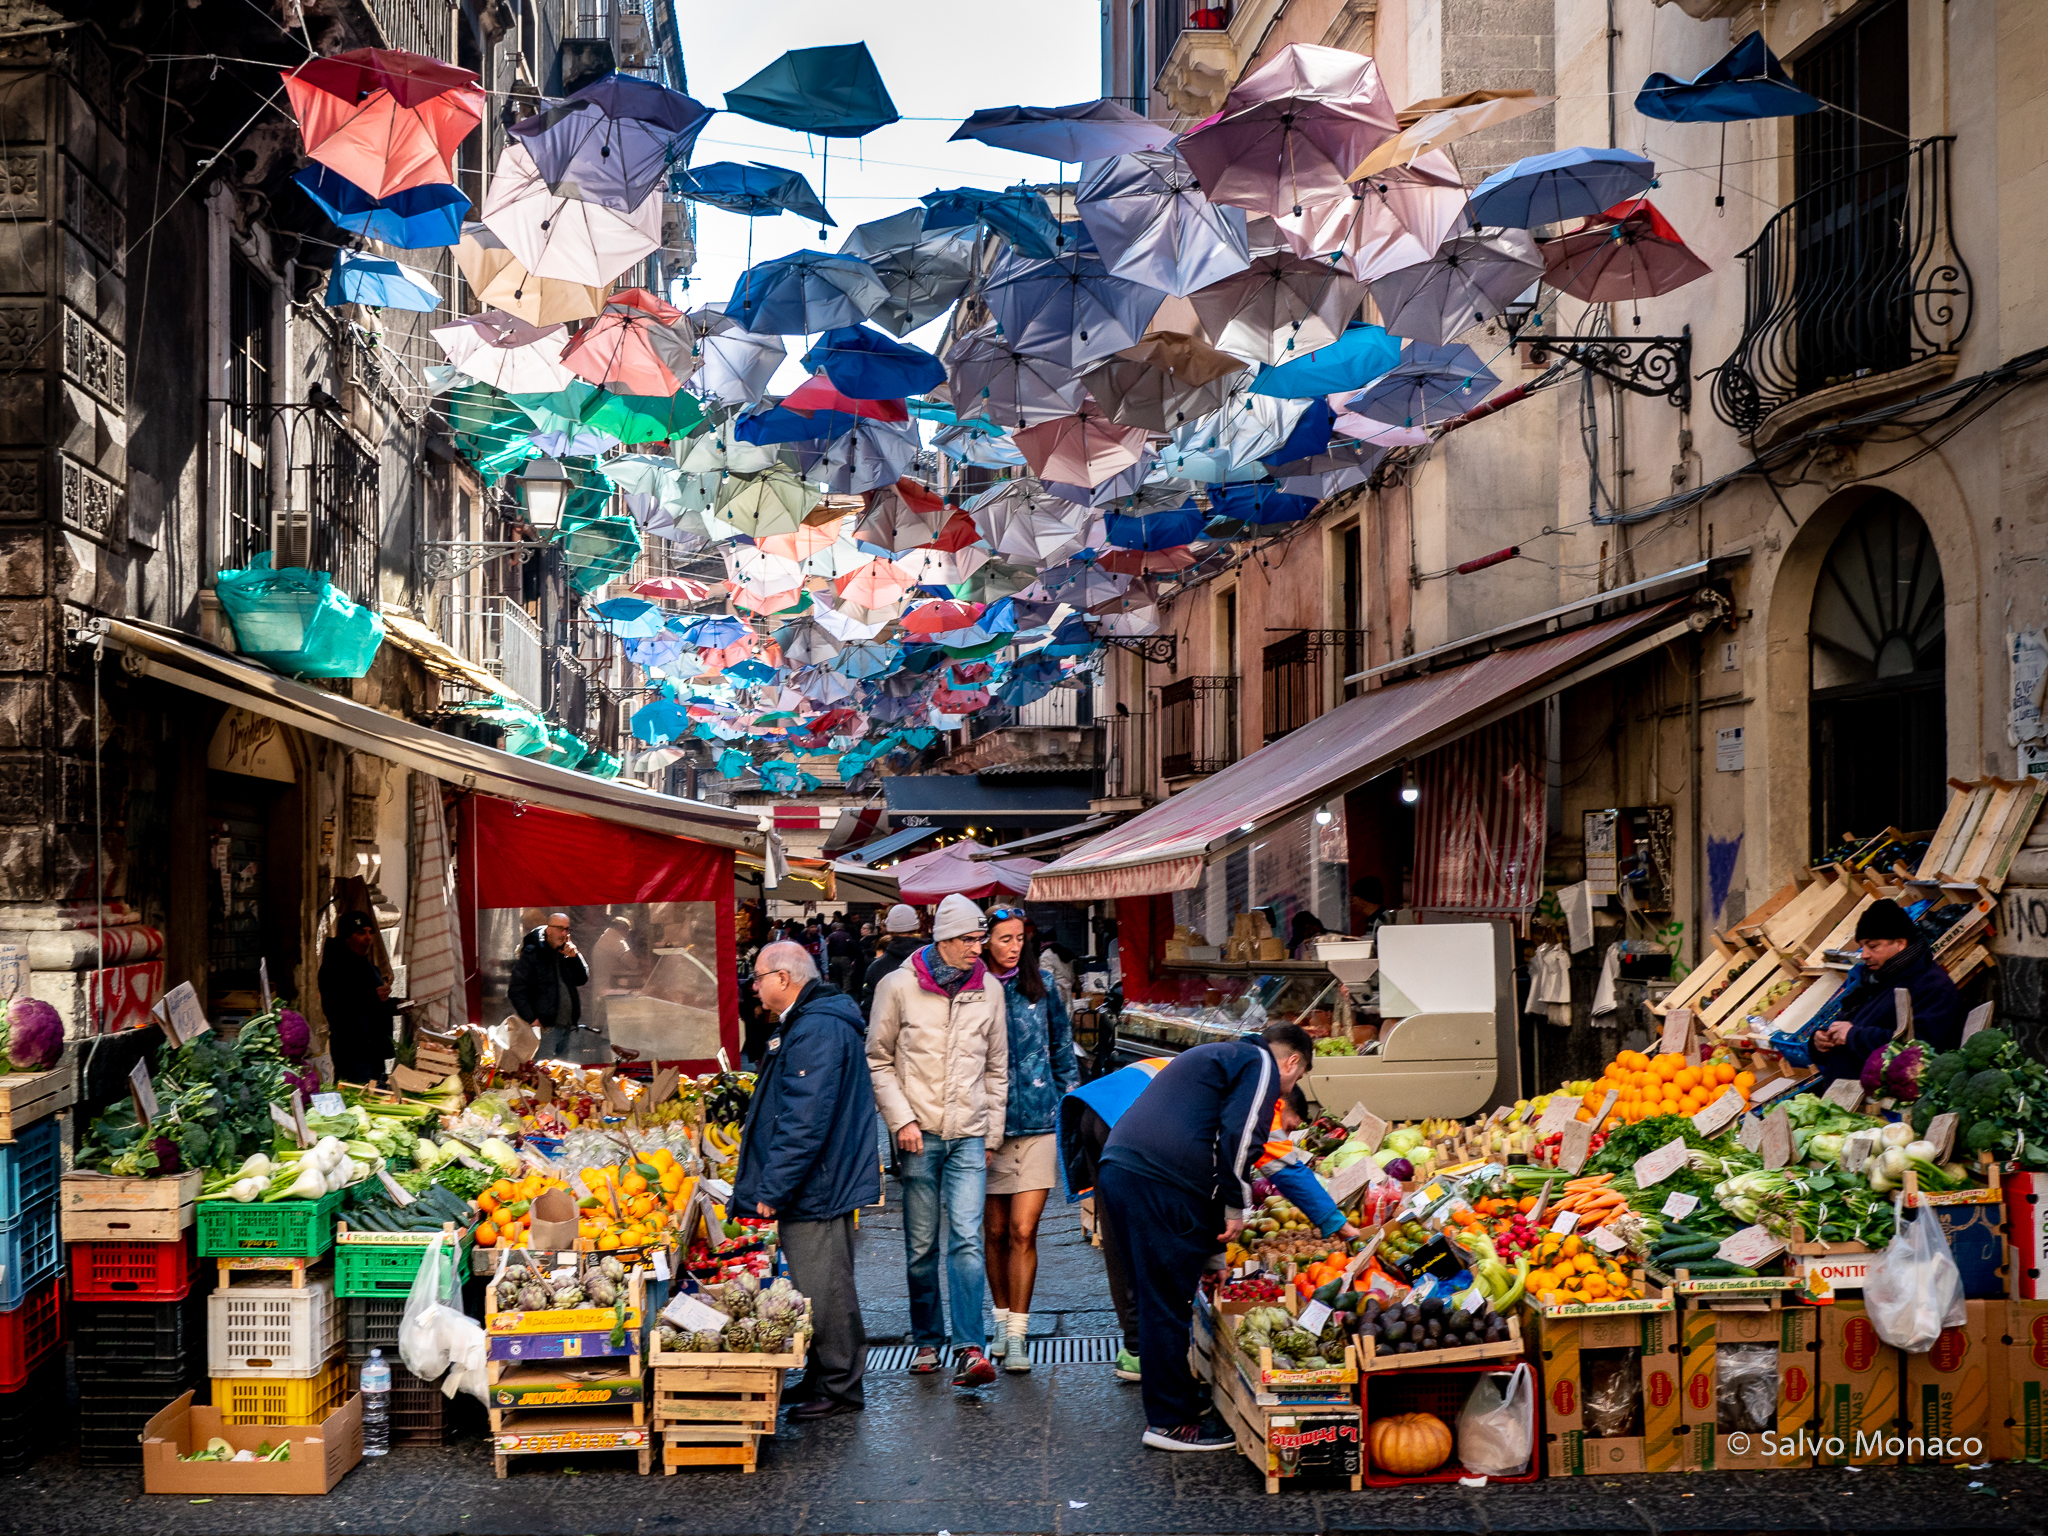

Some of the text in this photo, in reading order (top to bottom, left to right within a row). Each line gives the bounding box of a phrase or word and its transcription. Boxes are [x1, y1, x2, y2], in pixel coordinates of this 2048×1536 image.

[1931, 924, 1965, 954] Benny
[1697, 1282, 1717, 1290] Fichi
[1720, 1281, 1748, 1289] d'india
[1760, 1280, 1785, 1288] Sicilia
[1564, 1306, 1585, 1314] Fichi
[1587, 1304, 1615, 1313] d'india
[1628, 1302, 1654, 1310] Sicilia
[1852, 1320, 1863, 1368] Del Monte
[1942, 1352, 1951, 1368] Del
[1272, 1425, 1358, 1450] Le Primizie
[1836, 1401, 1848, 1459] Pmium
[1852, 1392, 1863, 1458] BNANAS
[2027, 1399, 2040, 1456] Premium
[1562, 1432, 1570, 1474] BANANAS
